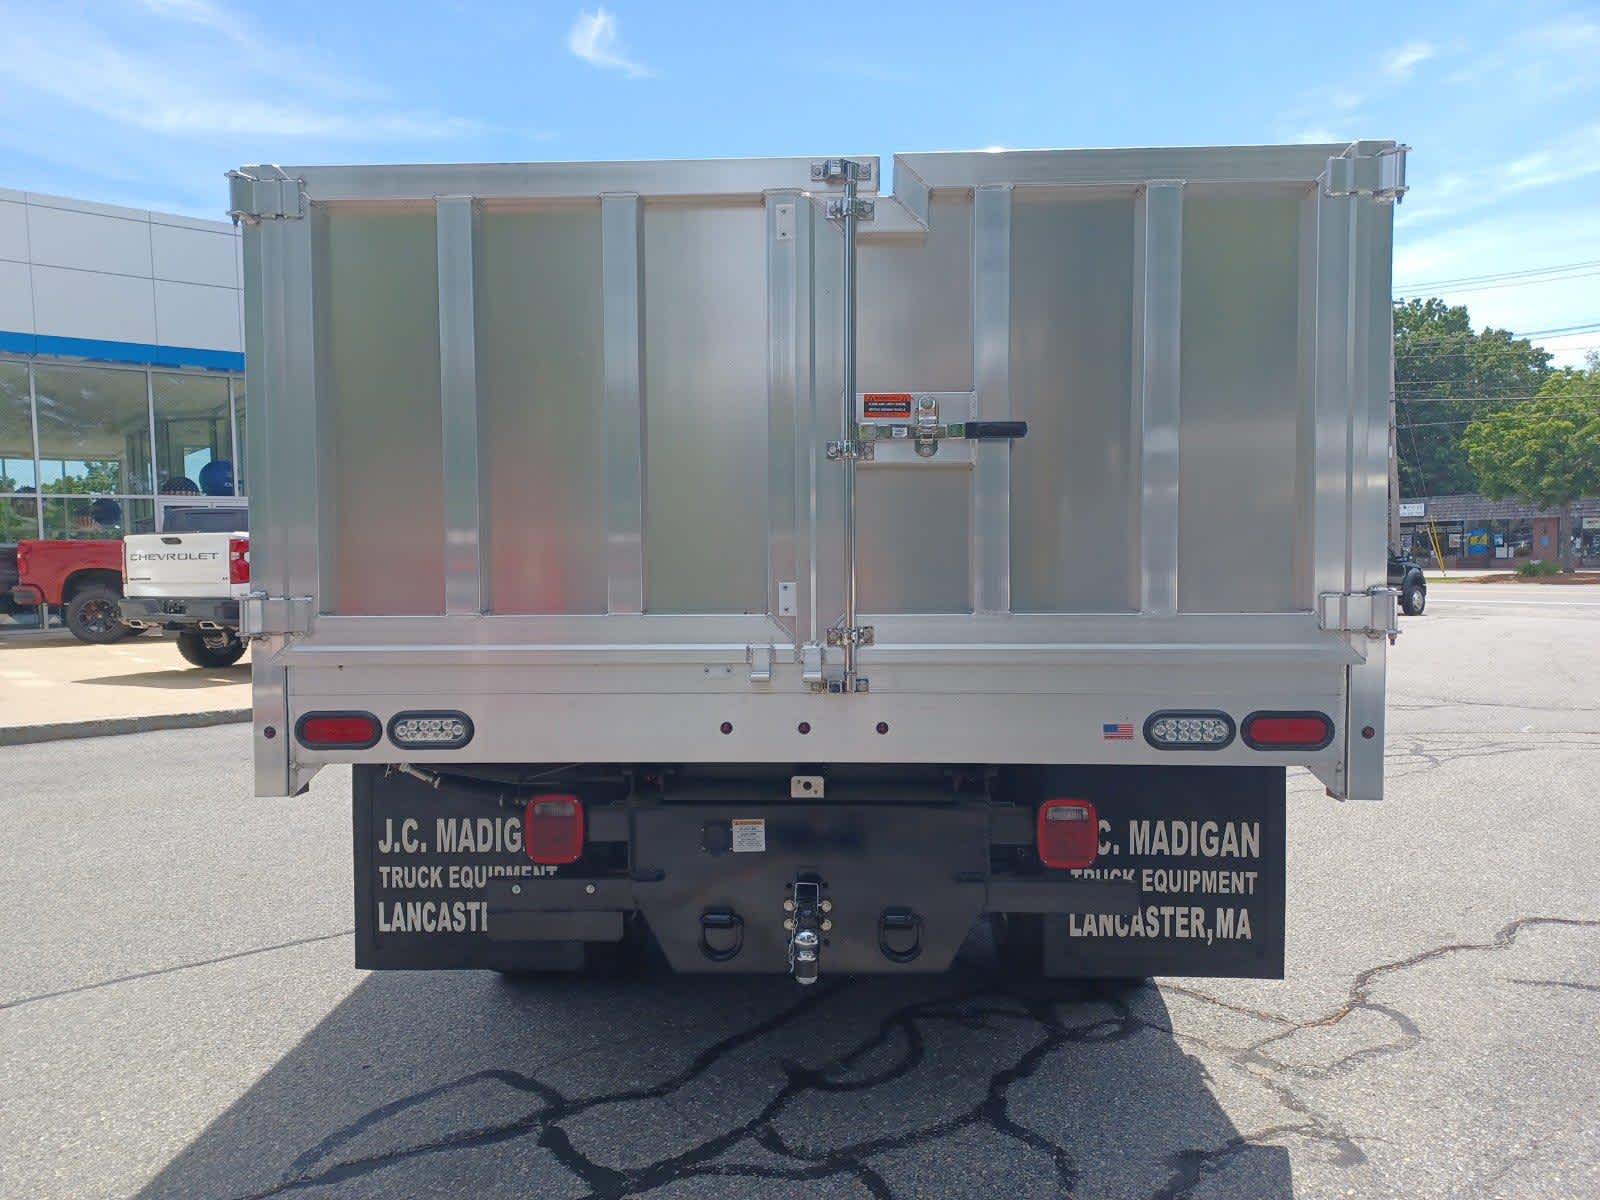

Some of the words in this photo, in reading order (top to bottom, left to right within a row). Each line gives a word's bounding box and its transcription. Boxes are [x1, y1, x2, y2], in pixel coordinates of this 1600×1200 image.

[129, 552, 219, 561] CHEVROLET
[378, 817, 428, 854] J.C.
[436, 817, 526, 854] MADIG
[1129, 820, 1260, 858] MADIGAN
[378, 866, 443, 889] TRUCK
[1142, 869, 1258, 895] EQUIPMENT
